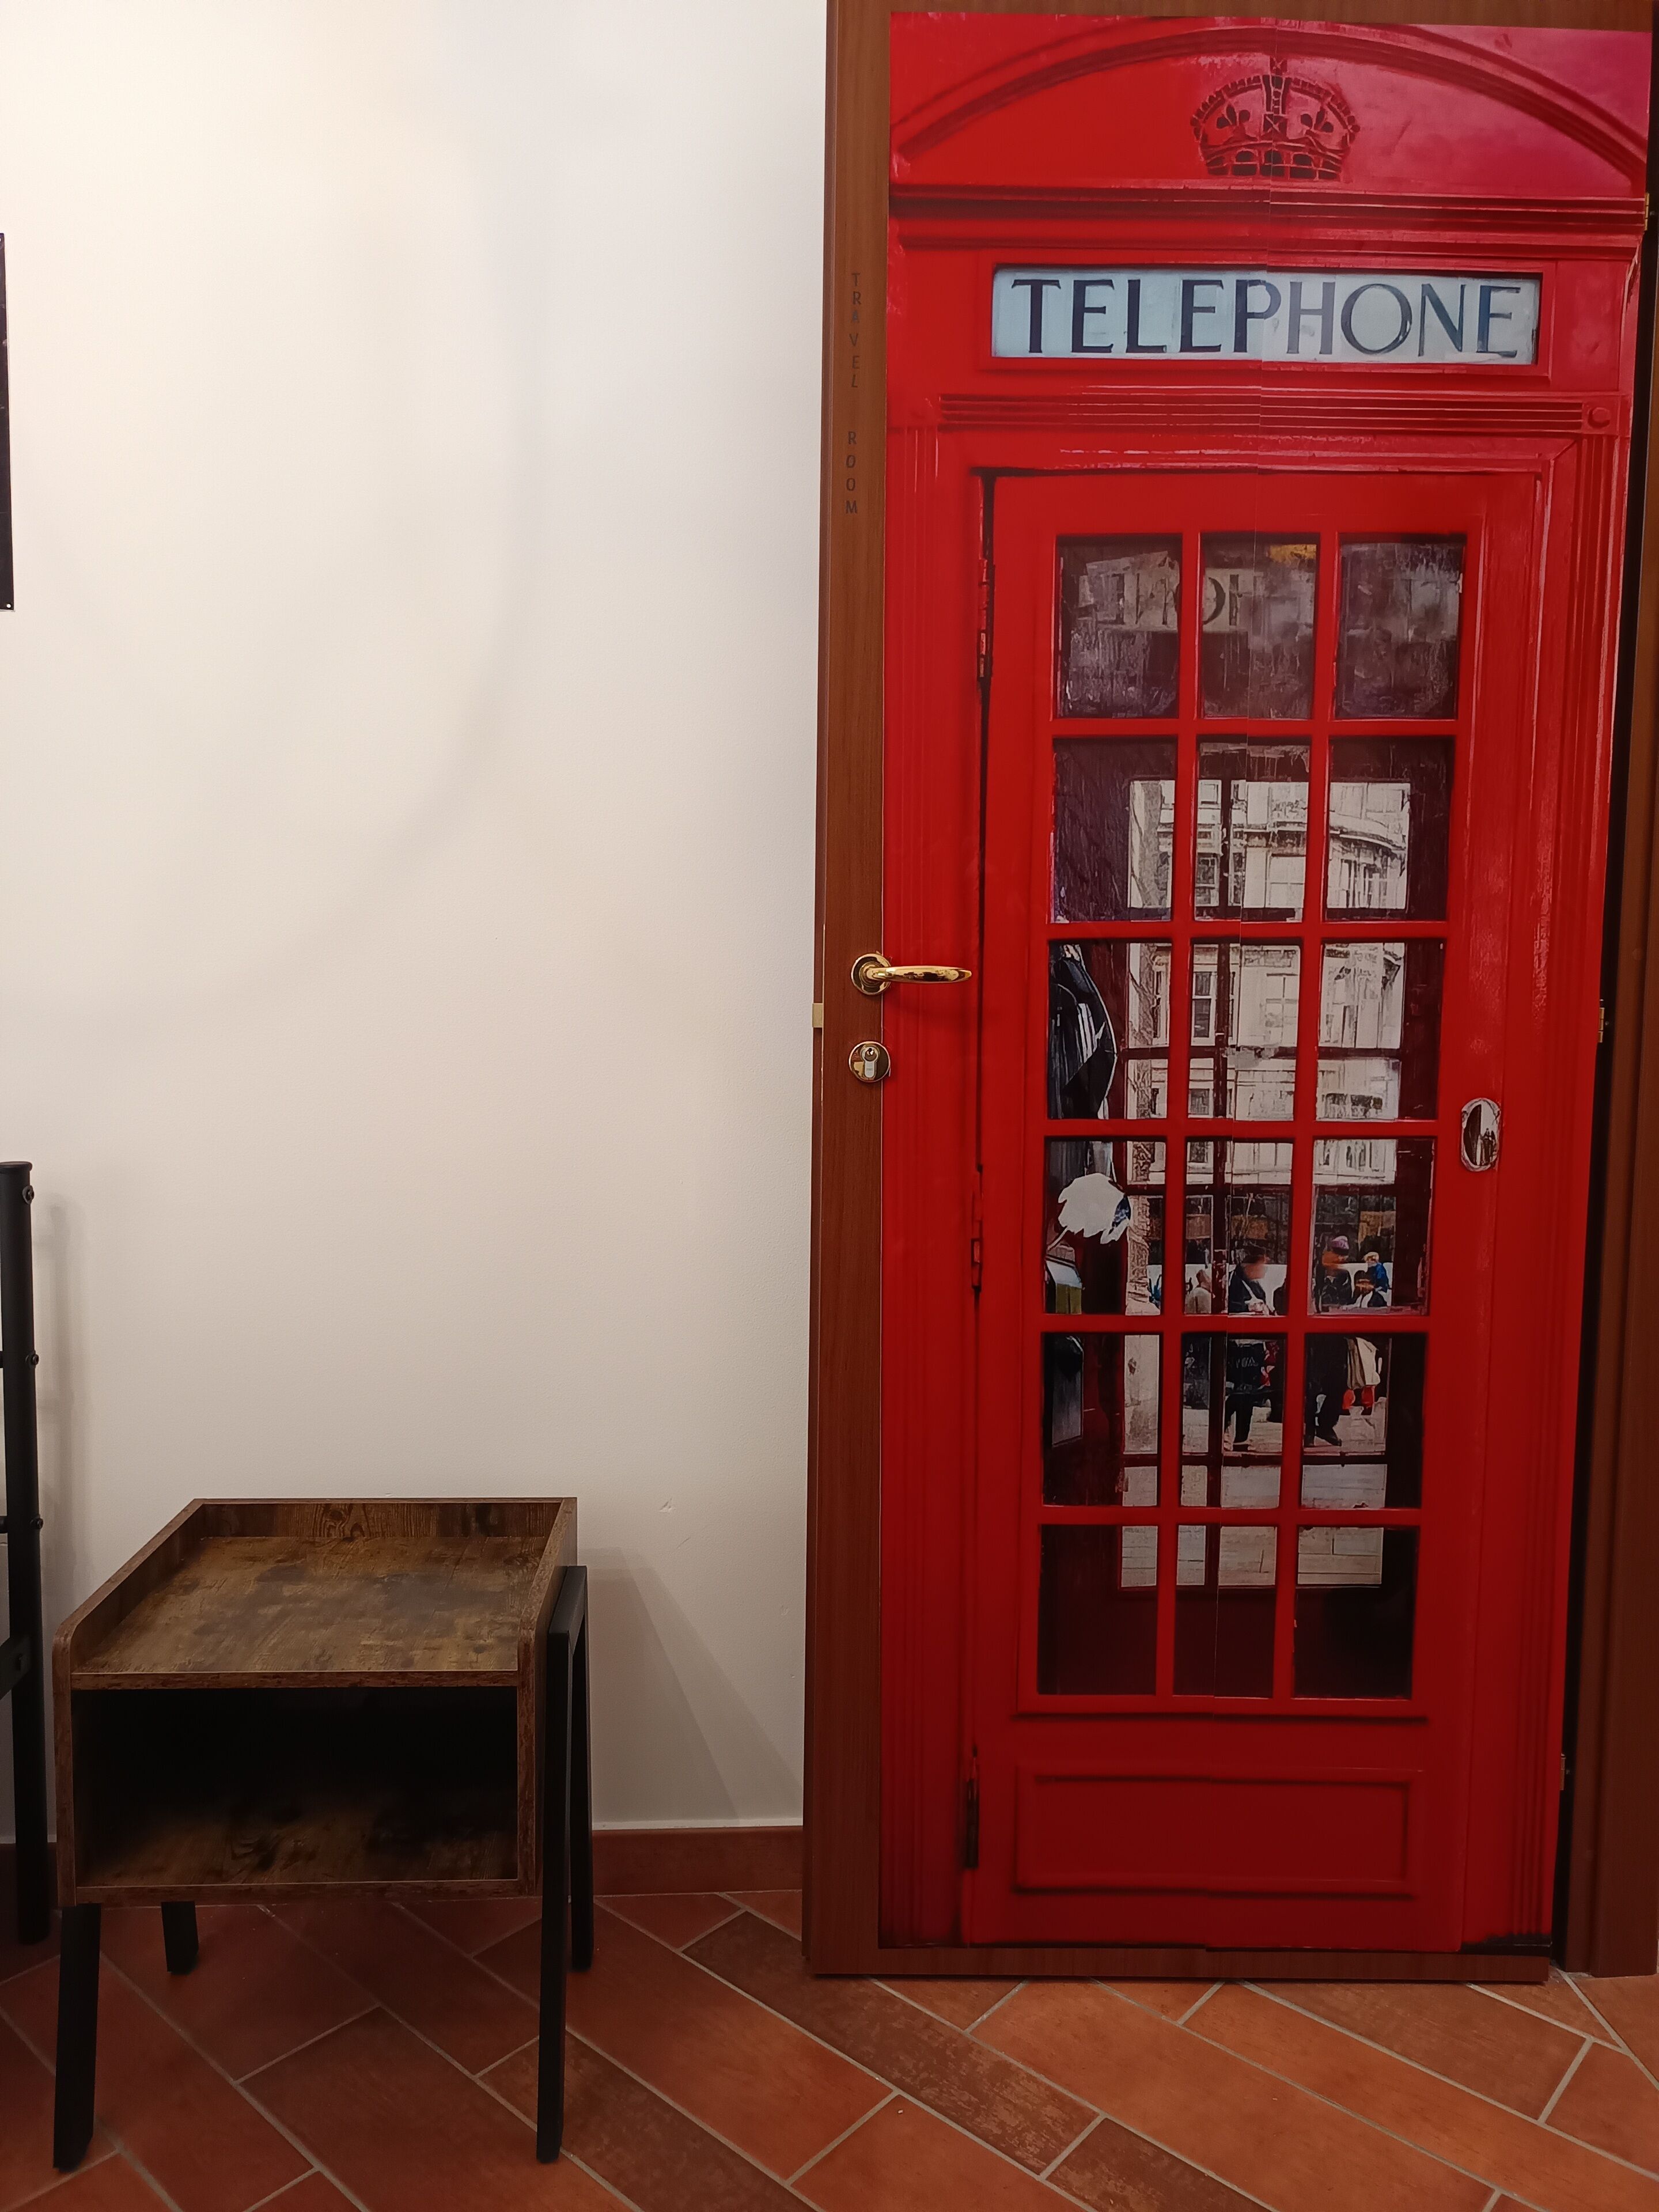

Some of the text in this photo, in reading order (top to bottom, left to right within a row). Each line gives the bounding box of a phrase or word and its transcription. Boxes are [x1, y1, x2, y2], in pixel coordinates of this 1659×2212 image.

[845, 272, 862, 514] TRAVEL ROOM
[1011, 278, 1521, 358] TELEPHONE
